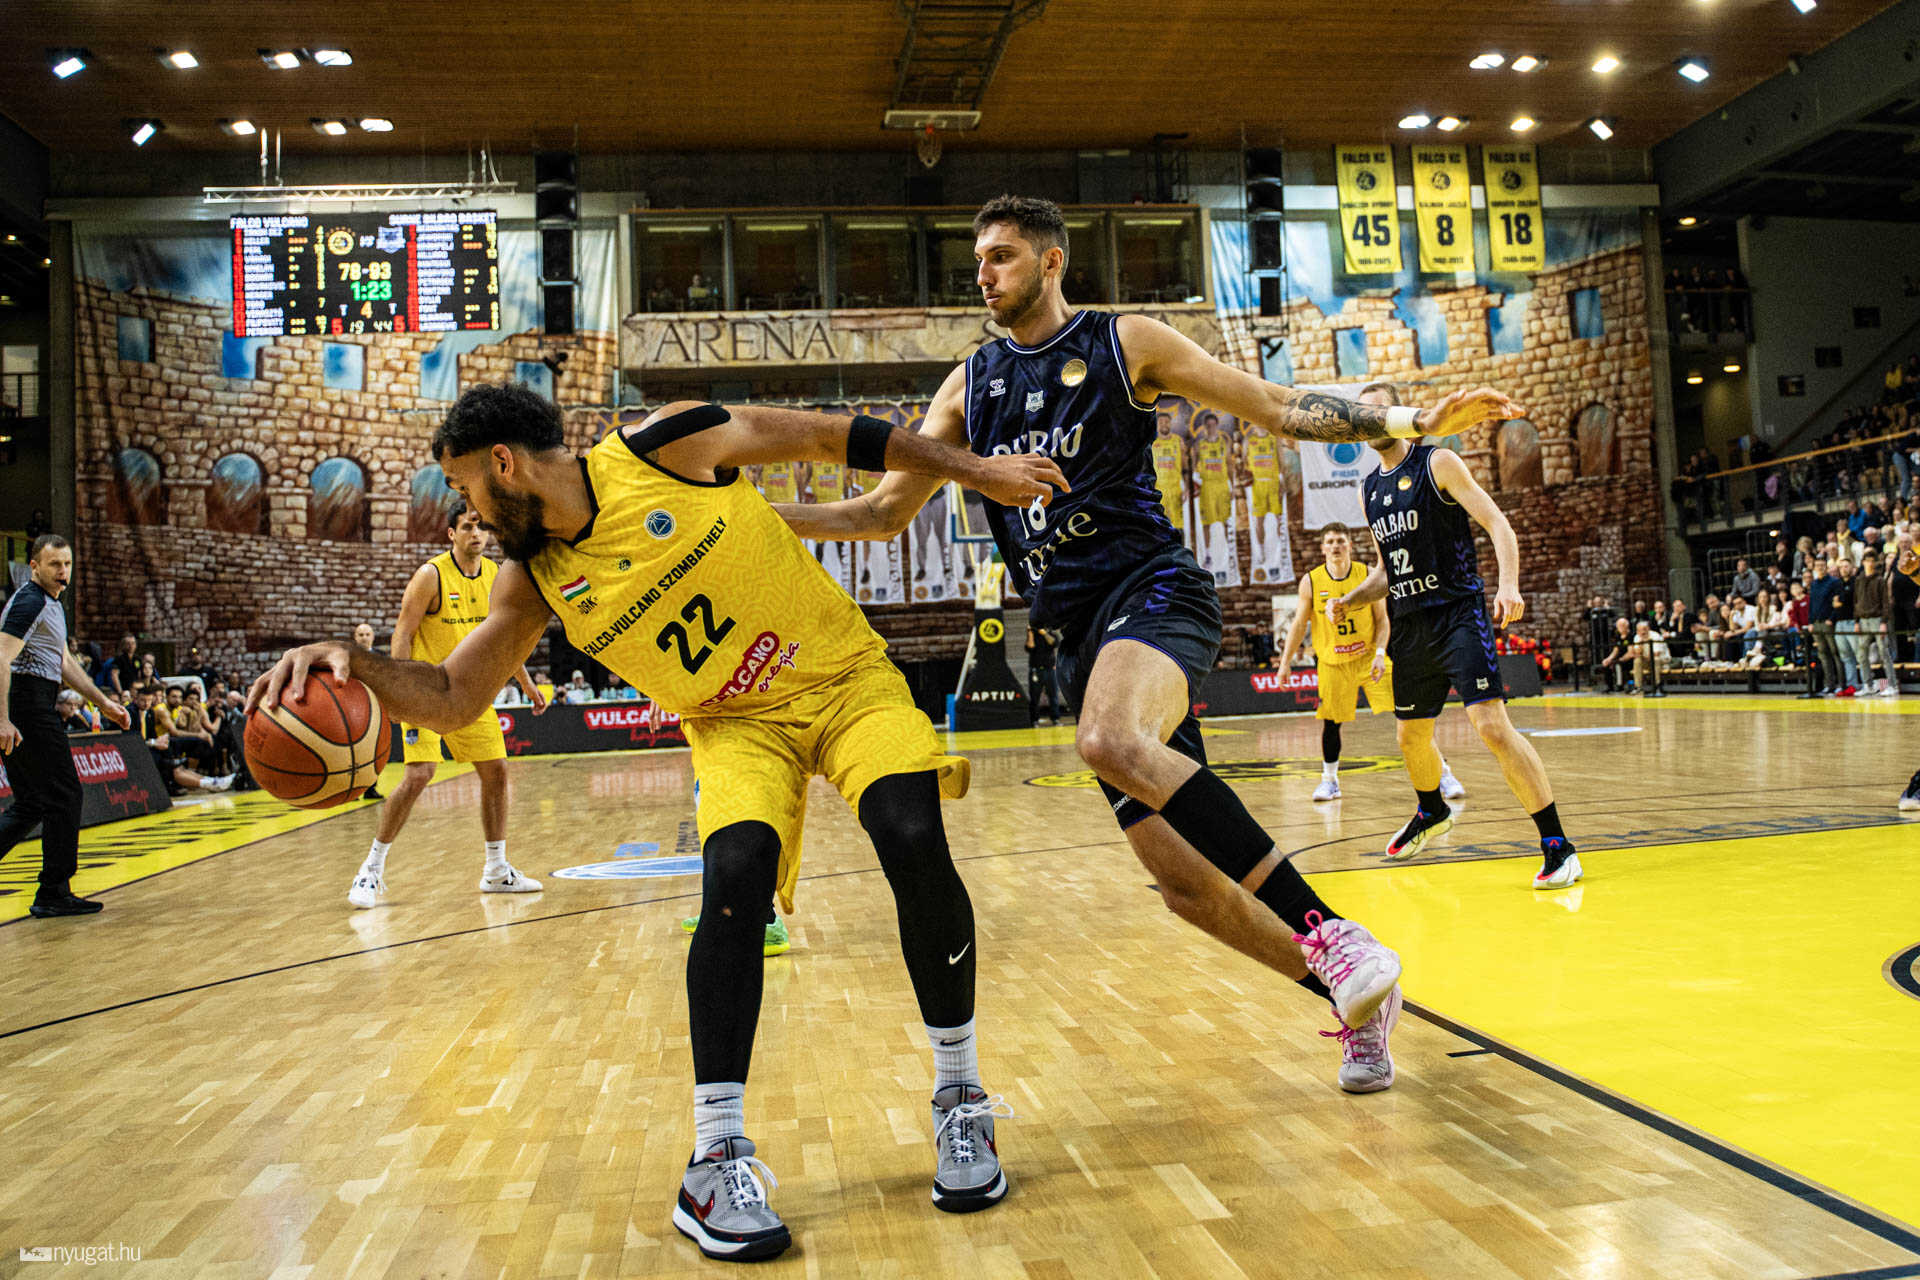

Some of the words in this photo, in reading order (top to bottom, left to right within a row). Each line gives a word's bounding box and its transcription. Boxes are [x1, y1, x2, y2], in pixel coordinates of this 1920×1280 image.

[1352, 214, 1391, 247] 45
[1436, 214, 1455, 246] 8
[1500, 213, 1533, 246] 18
[351, 280, 392, 301] 1:23
[360, 301, 373, 319] 4
[653, 319, 837, 363] ARENA
[1308, 480, 1357, 490] EUROPE
[657, 516, 727, 592] SZOMBATHELY
[656, 593, 736, 675] 22
[1337, 618, 1357, 636] 51
[700, 635, 777, 705] LCANO
[971, 691, 1015, 701] APTIV
